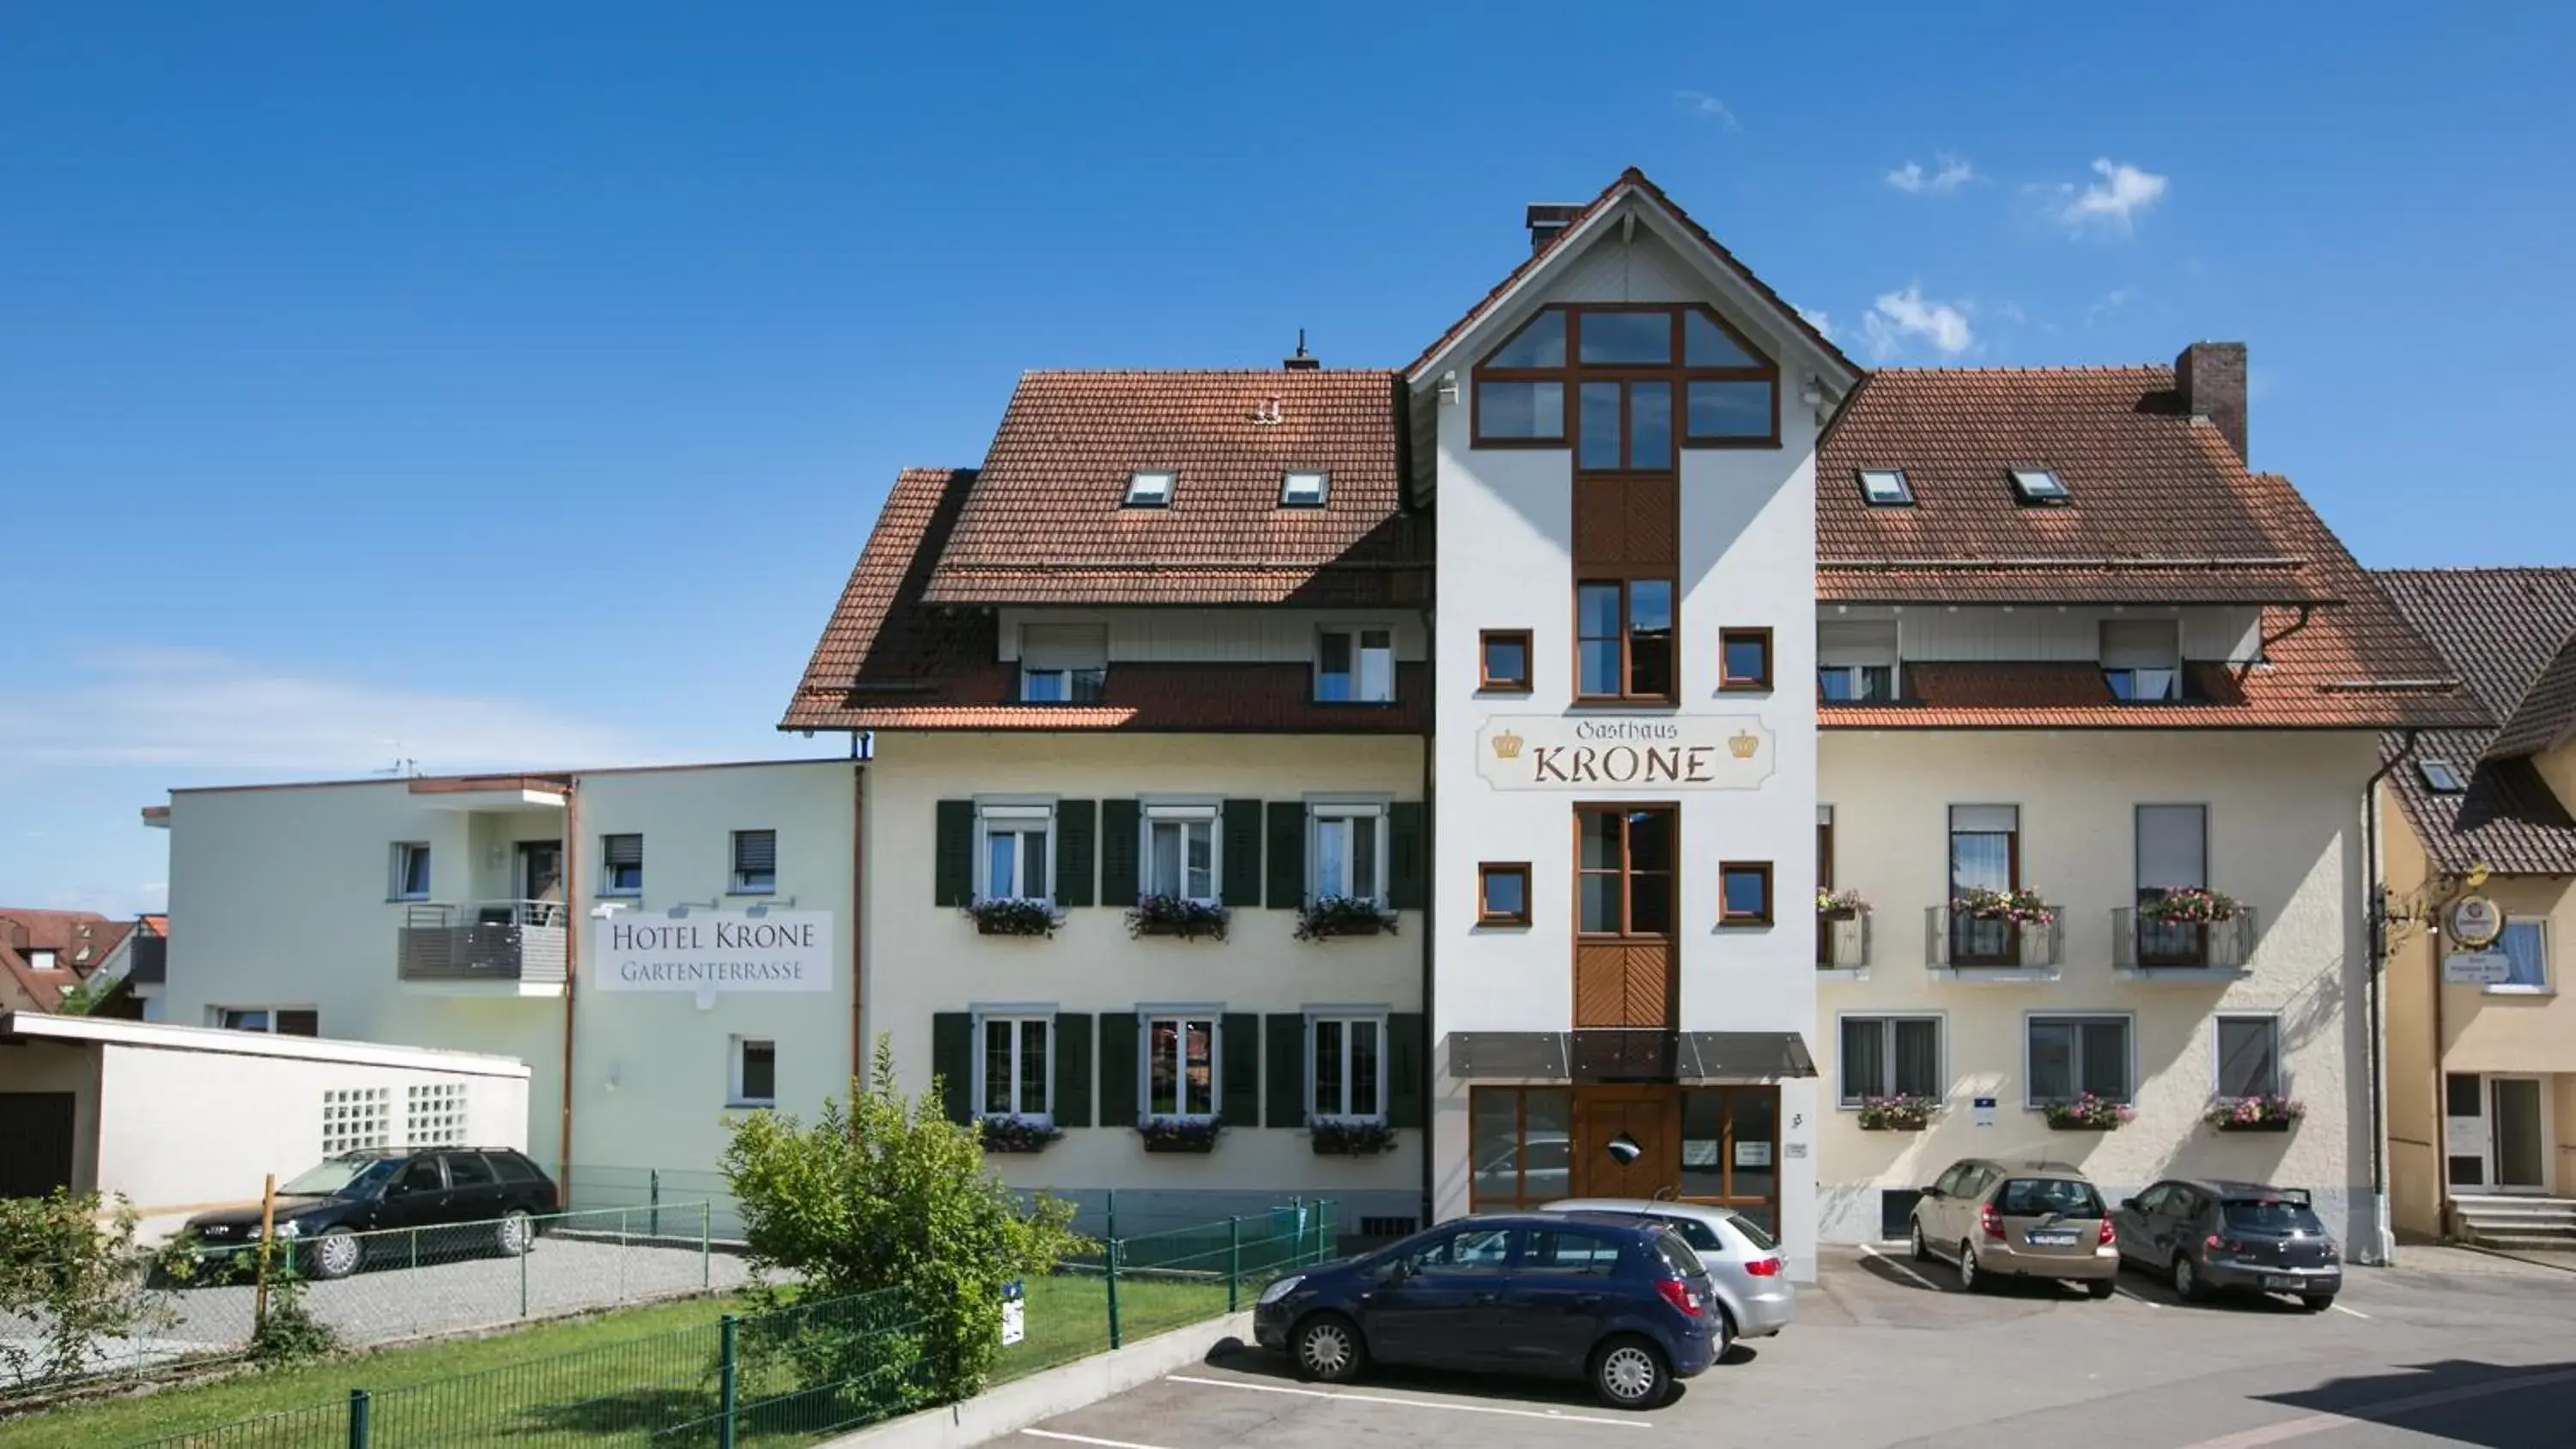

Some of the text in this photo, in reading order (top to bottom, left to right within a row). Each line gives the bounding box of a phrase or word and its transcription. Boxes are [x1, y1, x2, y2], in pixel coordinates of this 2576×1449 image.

[1575, 720, 1678, 740] Gasthaus
[1533, 746, 1715, 782] KRONE
[613, 921, 815, 950] HOTEL KRONE
[621, 960, 804, 982] GARTENTERRASSE
